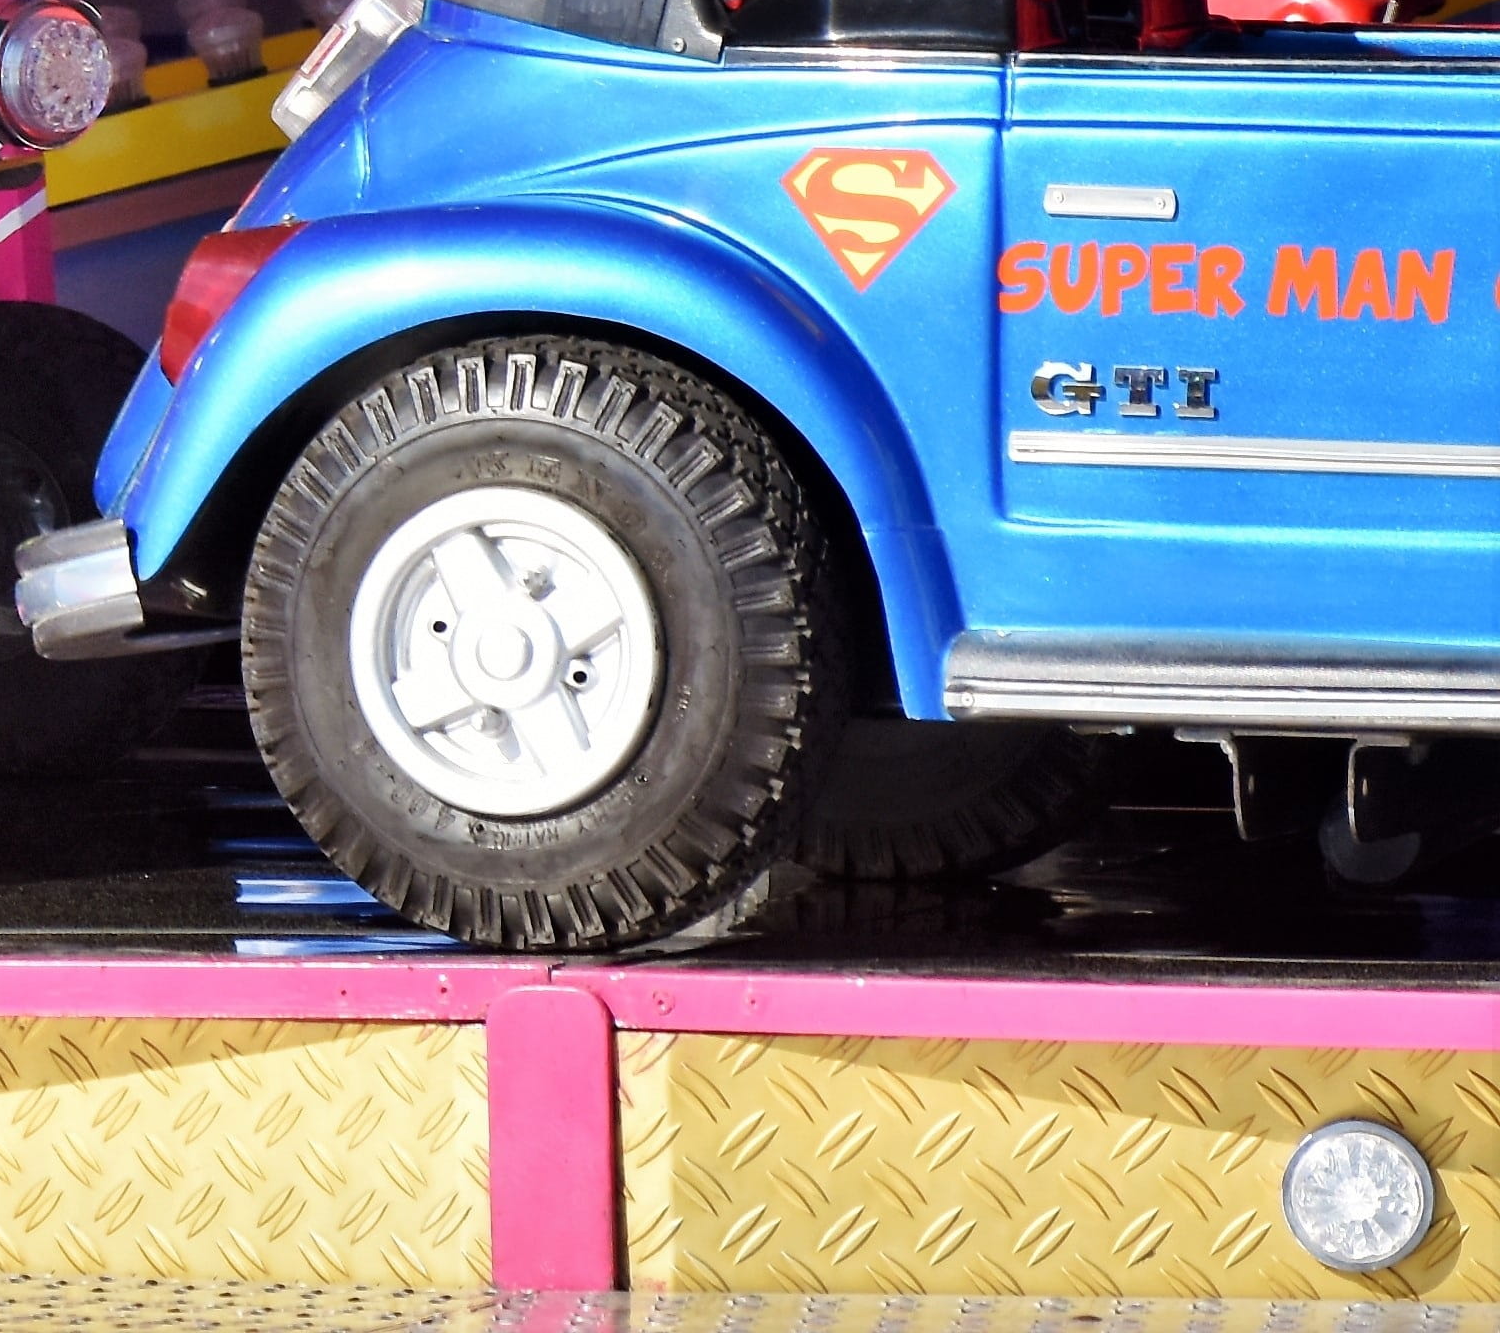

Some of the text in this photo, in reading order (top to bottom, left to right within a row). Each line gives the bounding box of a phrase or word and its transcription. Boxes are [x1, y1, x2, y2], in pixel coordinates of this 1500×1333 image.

[997, 240, 1246, 320] SUPER
[1266, 244, 1456, 325] MAN
[1029, 359, 1221, 420] GTI
